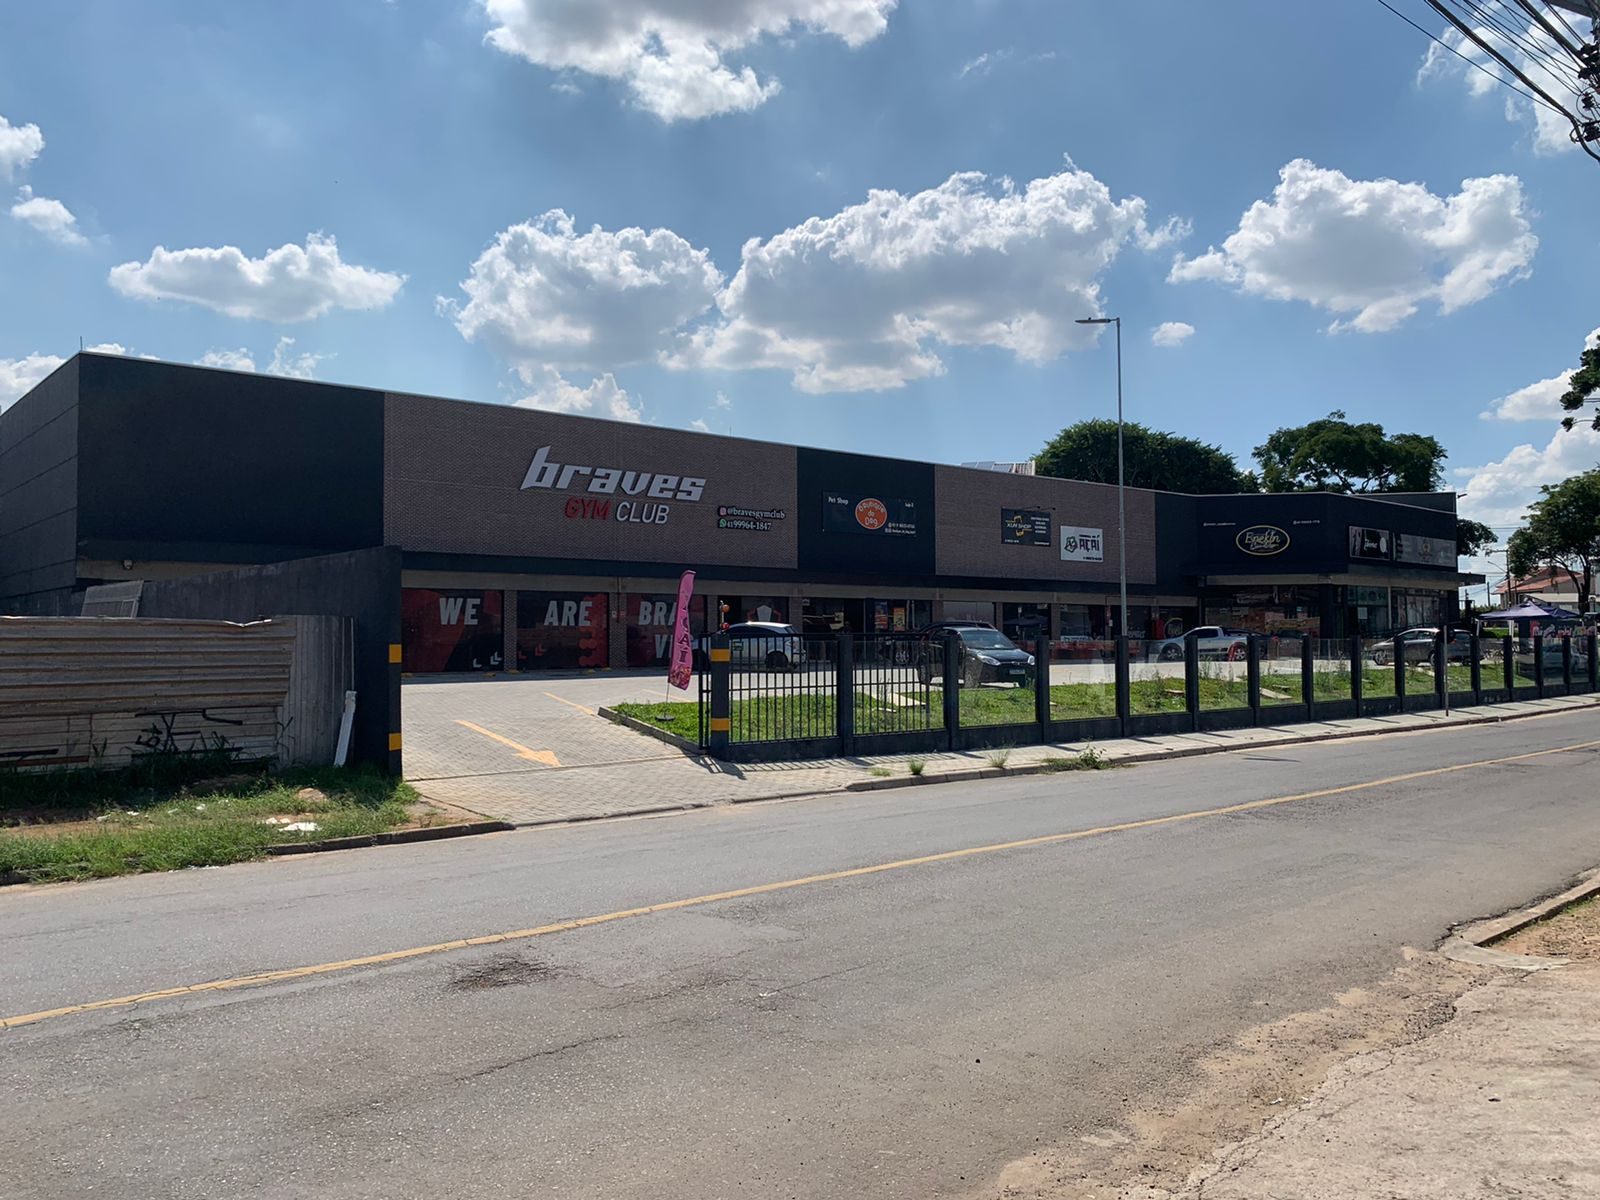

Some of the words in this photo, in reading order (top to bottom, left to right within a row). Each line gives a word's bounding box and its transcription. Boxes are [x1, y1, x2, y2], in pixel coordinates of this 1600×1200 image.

[520, 445, 706, 502] braves
[565, 497, 611, 520] GYM
[616, 501, 669, 524] CLUB
[1079, 535, 1100, 553] AÇAÍ
[439, 598, 480, 625] WE
[544, 600, 592, 627] ARE
